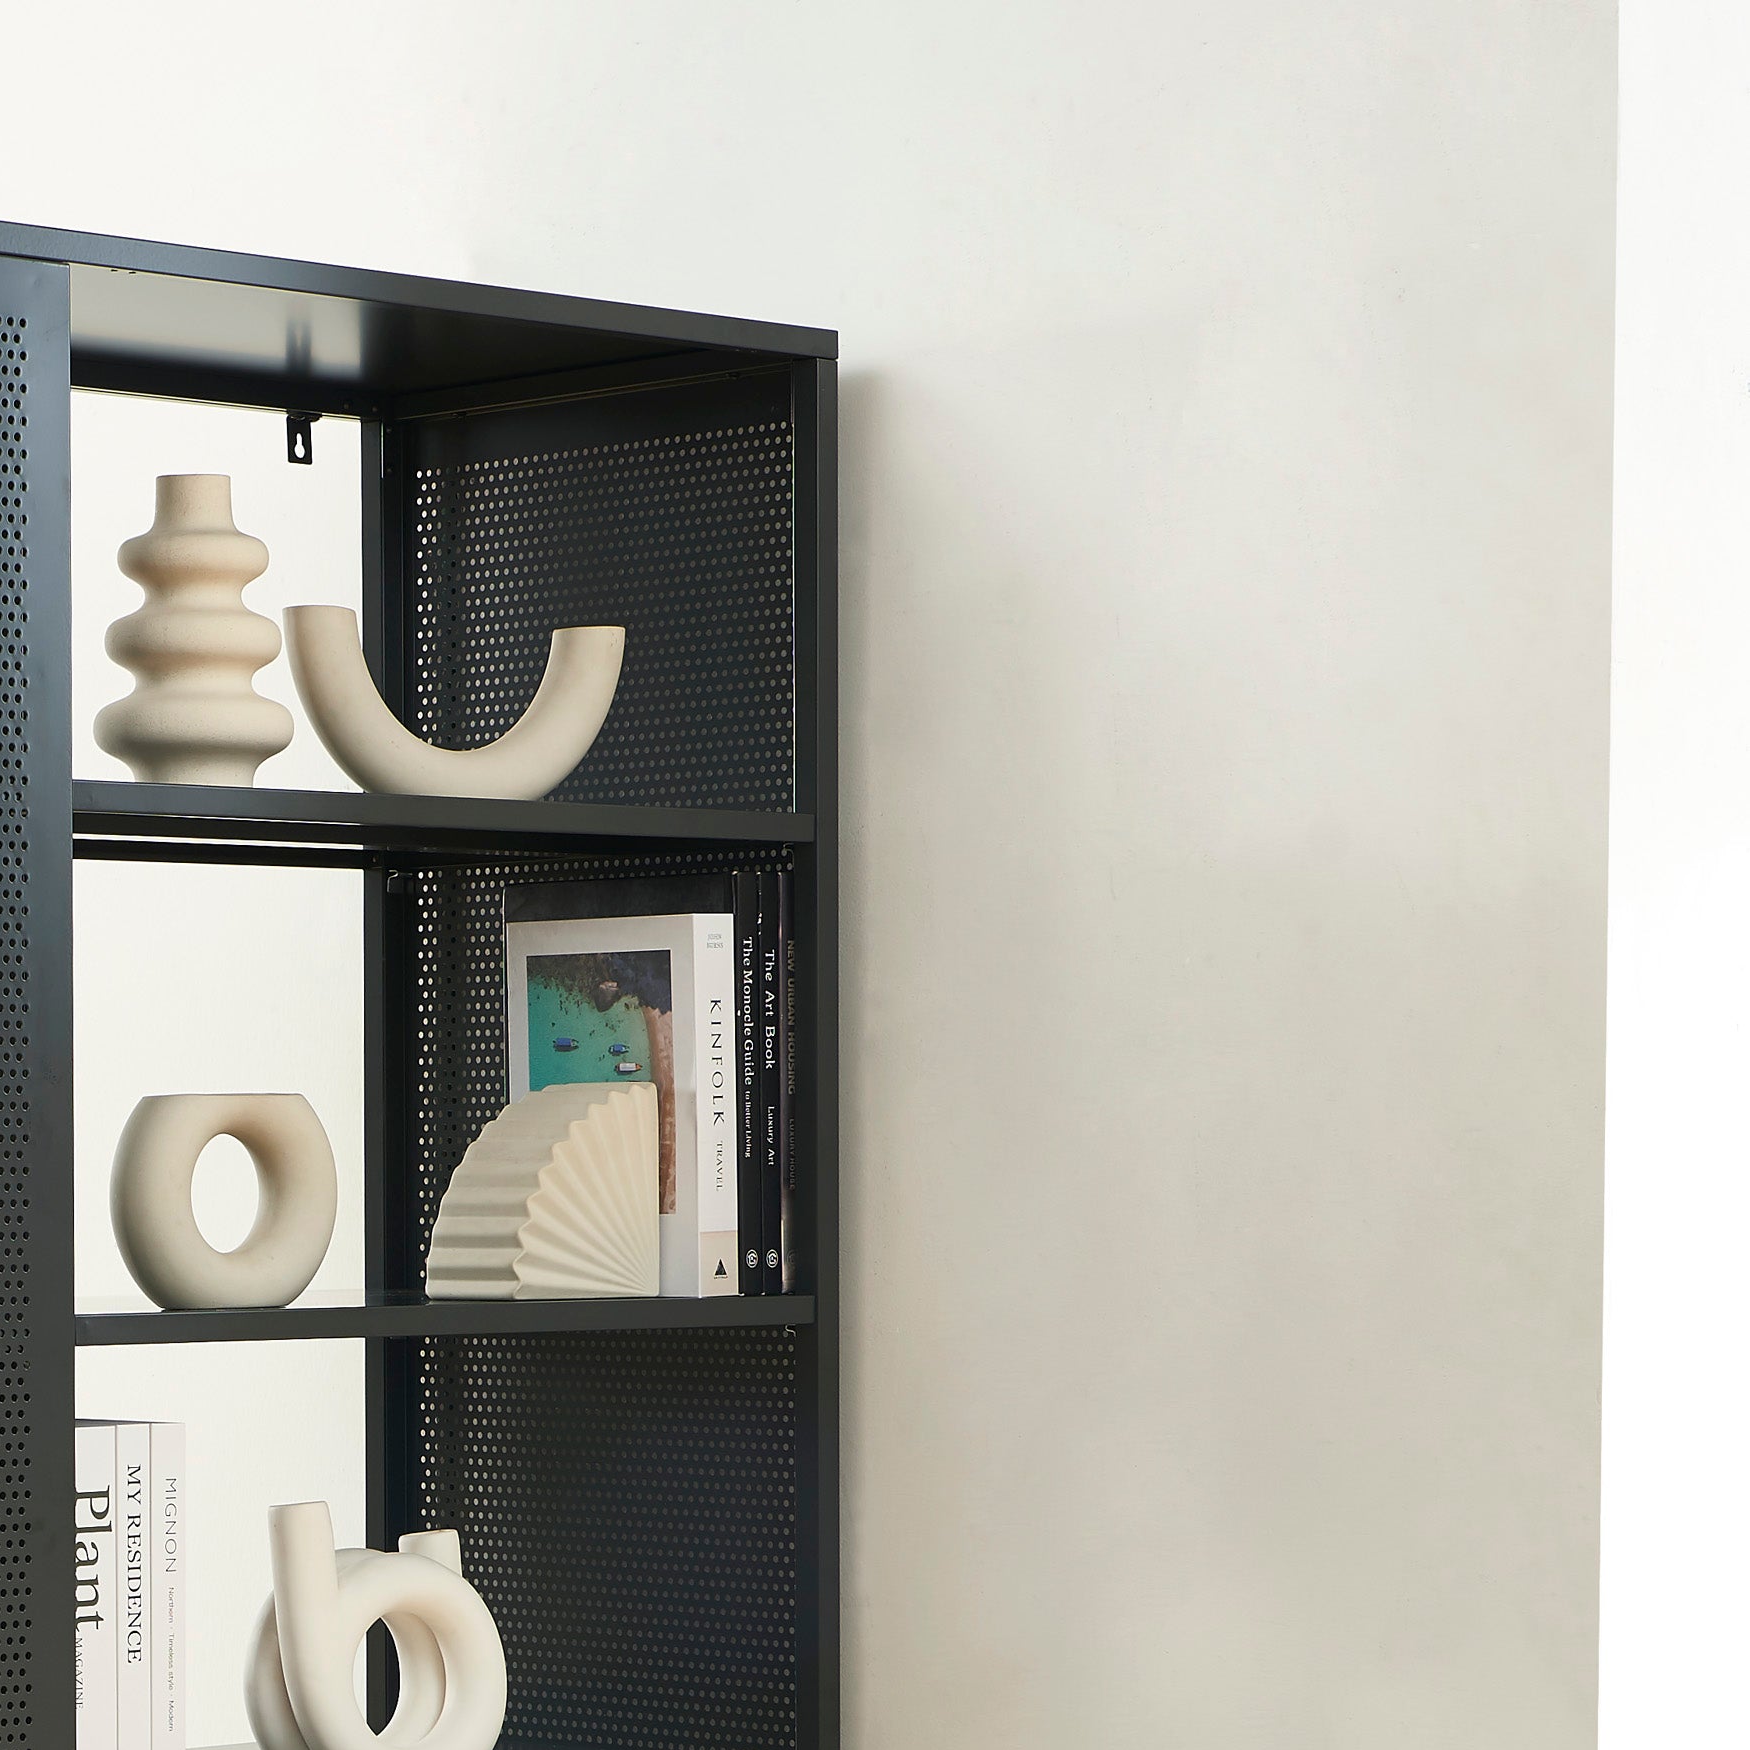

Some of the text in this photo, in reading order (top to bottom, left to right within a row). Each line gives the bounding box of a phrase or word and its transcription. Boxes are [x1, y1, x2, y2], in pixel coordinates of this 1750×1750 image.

[742, 936, 753, 966] The
[742, 970, 755, 1037] Monocle
[764, 948, 776, 1070] The Art Book
[787, 940, 796, 1096] NEW URBAN HOUSING
[710, 999, 725, 1126] KINFOLK
[743, 1039, 755, 1086] Guide
[744, 1090, 751, 1100] to
[744, 1130, 752, 1159] Living
[766, 1106, 776, 1166] Luxury Art
[75, 1484, 113, 1633] Plant
[164, 1478, 178, 1573] MIGNON
[127, 1464, 142, 1664] MY RESIDENCE
[75, 1637, 84, 1710] MAGAZINE
